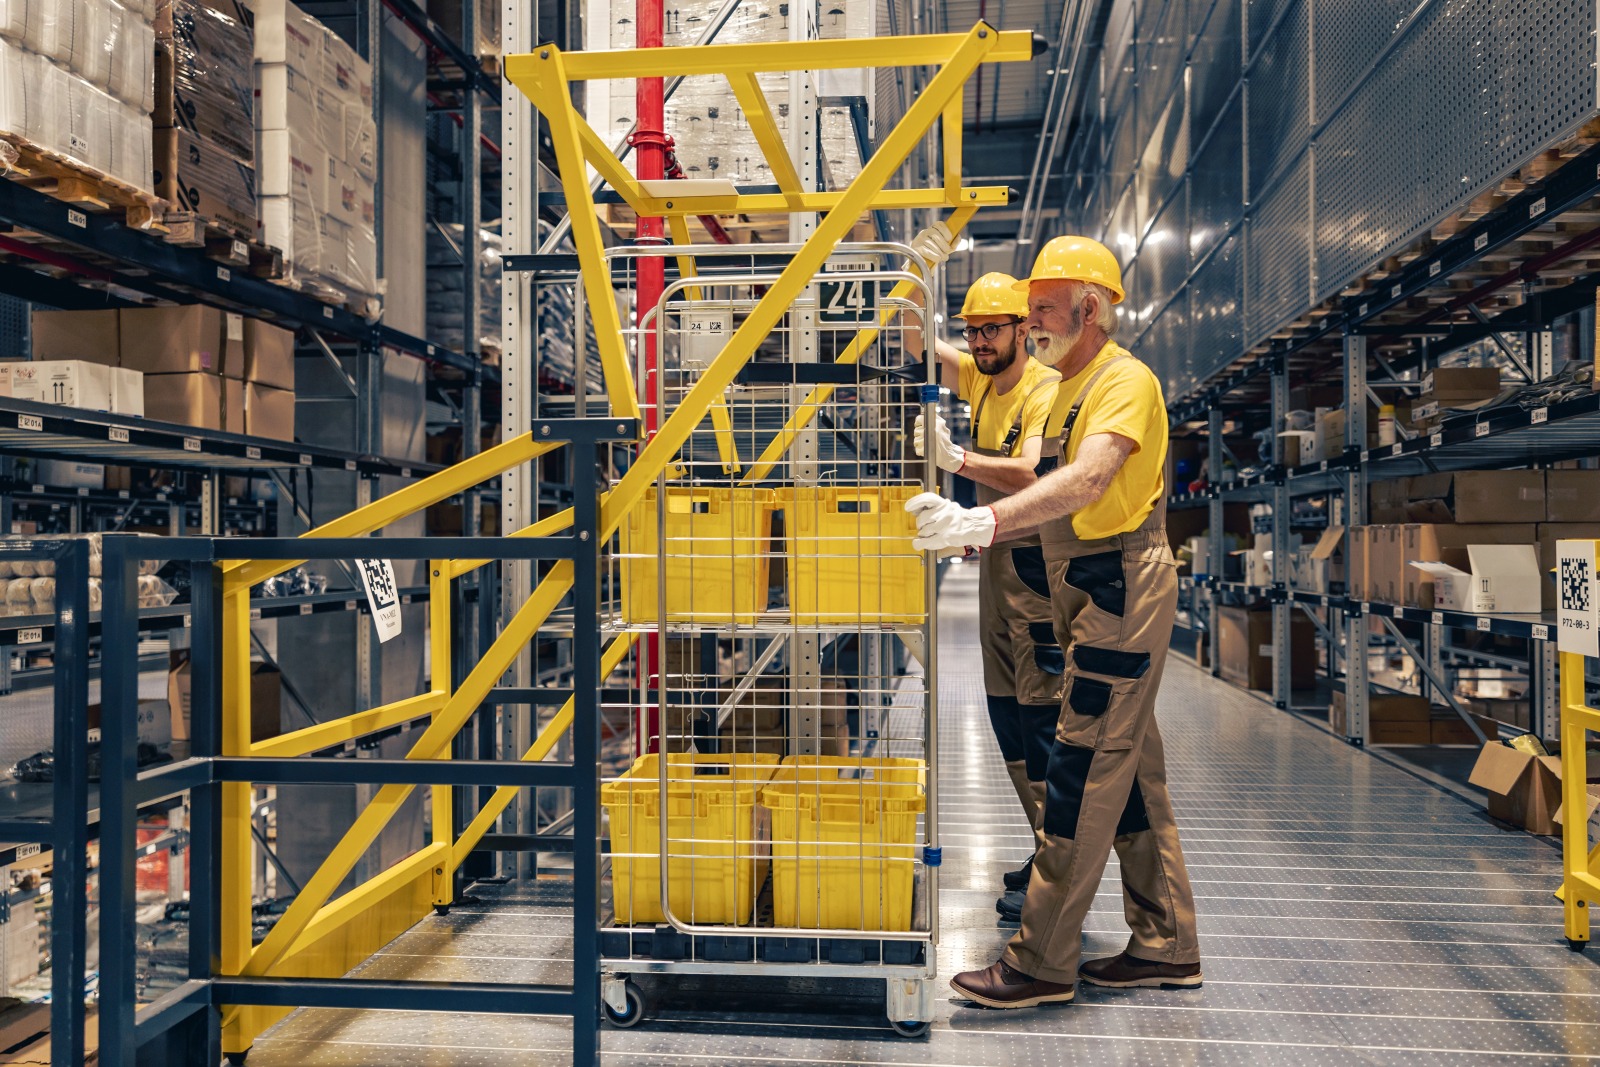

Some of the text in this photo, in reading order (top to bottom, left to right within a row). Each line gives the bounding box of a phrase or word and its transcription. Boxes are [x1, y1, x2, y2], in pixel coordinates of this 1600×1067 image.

[827, 278, 866, 315] 24
[30, 420, 42, 428] 01A
[28, 845, 40, 854] 01A
